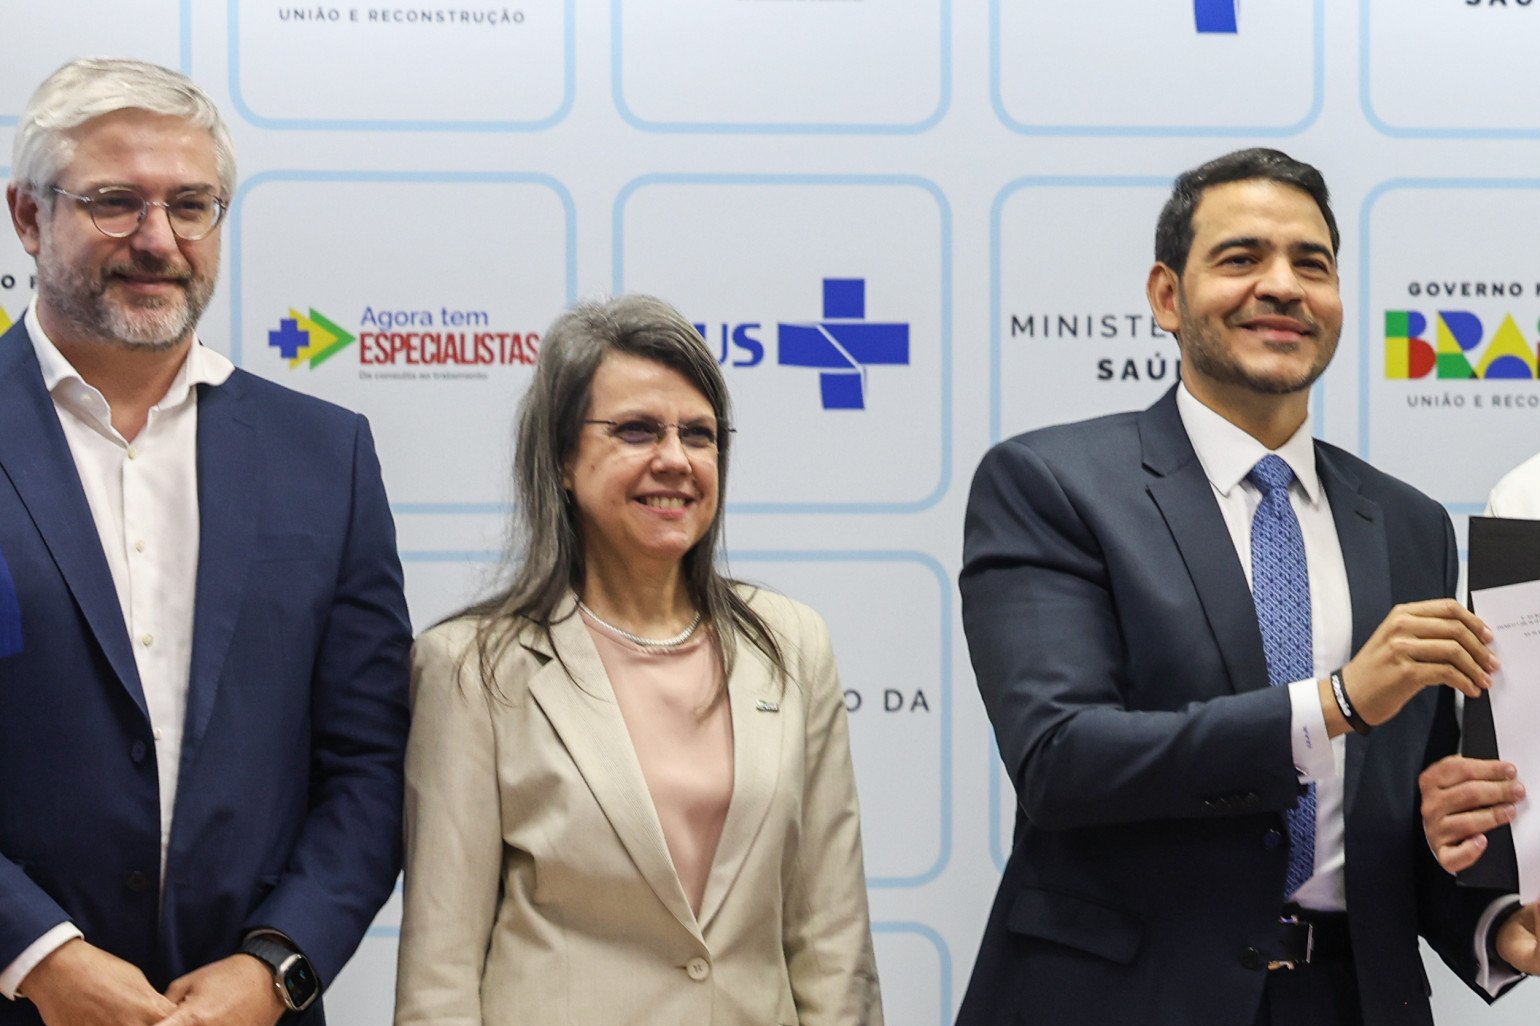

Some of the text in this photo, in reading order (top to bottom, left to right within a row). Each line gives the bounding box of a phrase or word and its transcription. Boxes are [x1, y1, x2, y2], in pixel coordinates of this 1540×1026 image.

[278, 7, 526, 27] UNIÃO E RECONSTRUÇÃO
[1408, 283, 1523, 297] GOVERNO
[360, 306, 489, 332] Agora tem
[1011, 315, 1165, 338] MINIST
[359, 332, 539, 365] ESPECIALISTAS
[693, 323, 765, 368] US
[1097, 352, 1182, 382] SAÚ
[1407, 391, 1465, 408] UNIÃO
[1474, 394, 1483, 408] E
[884, 689, 930, 713] DA
